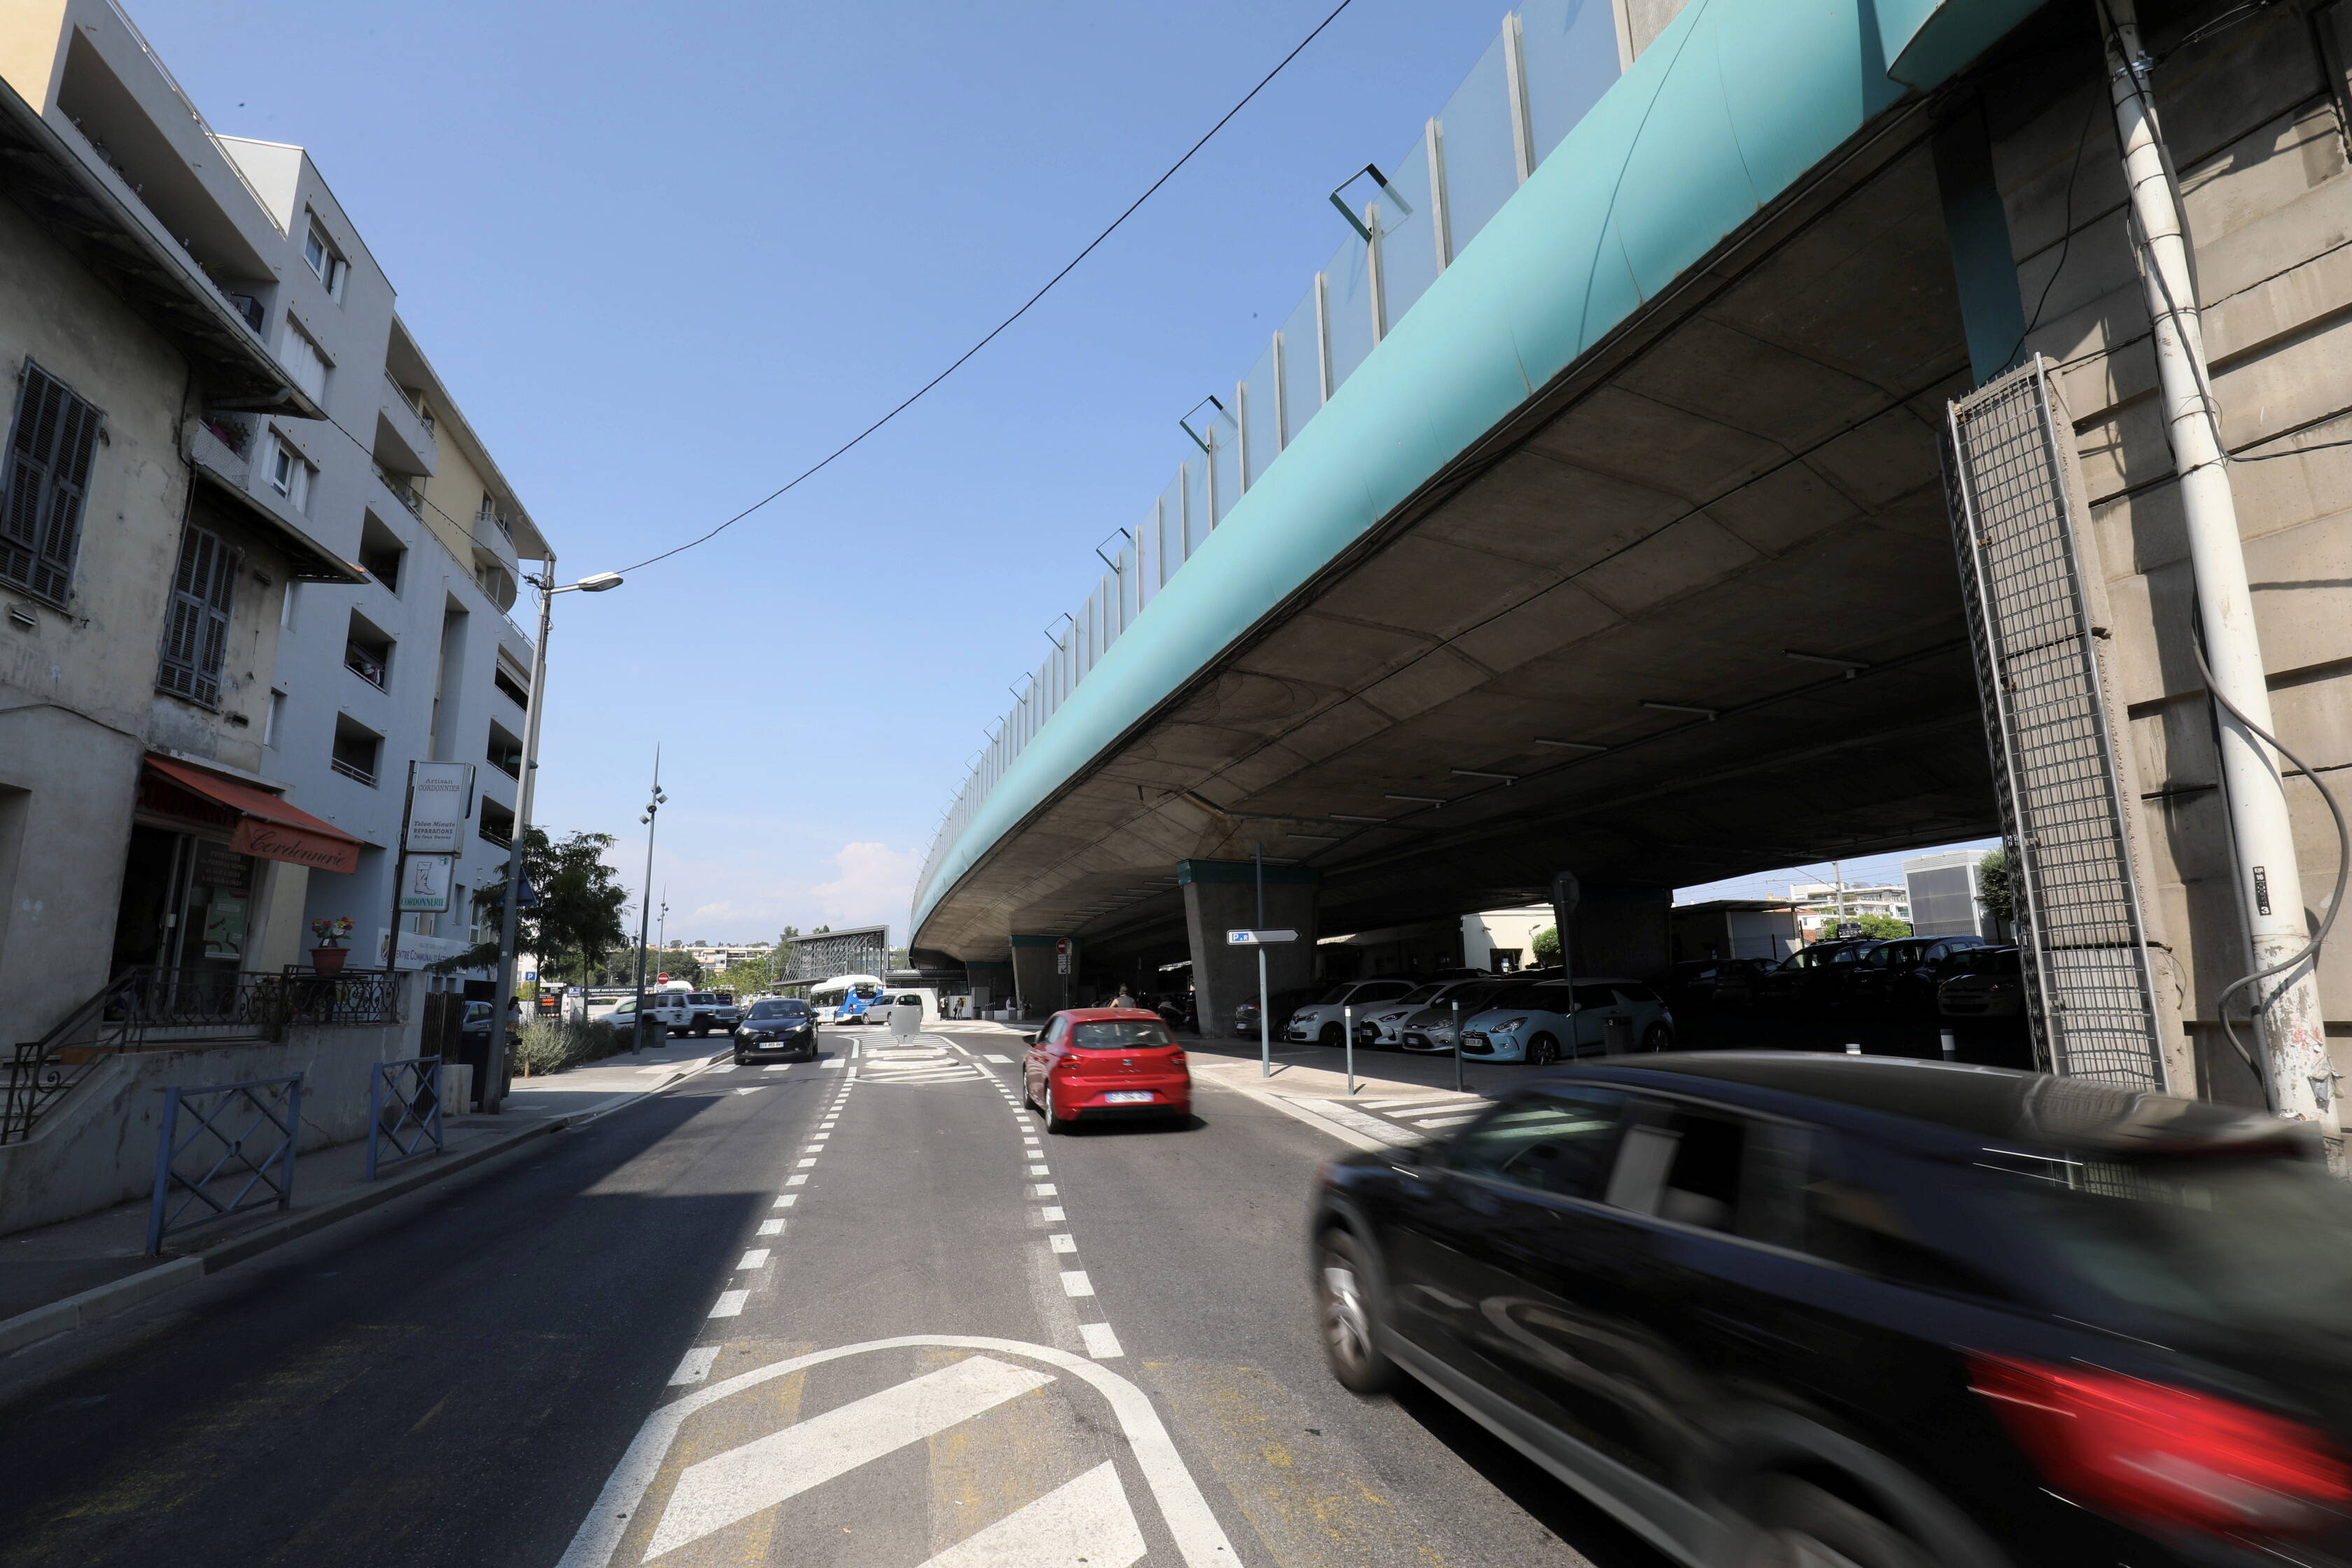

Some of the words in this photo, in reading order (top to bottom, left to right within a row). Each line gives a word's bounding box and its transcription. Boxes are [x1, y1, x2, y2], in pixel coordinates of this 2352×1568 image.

[250, 829, 346, 866] Cordonnerie
[402, 897, 444, 906] CORDONNERIE
[396, 950, 410, 960] ENTRE
